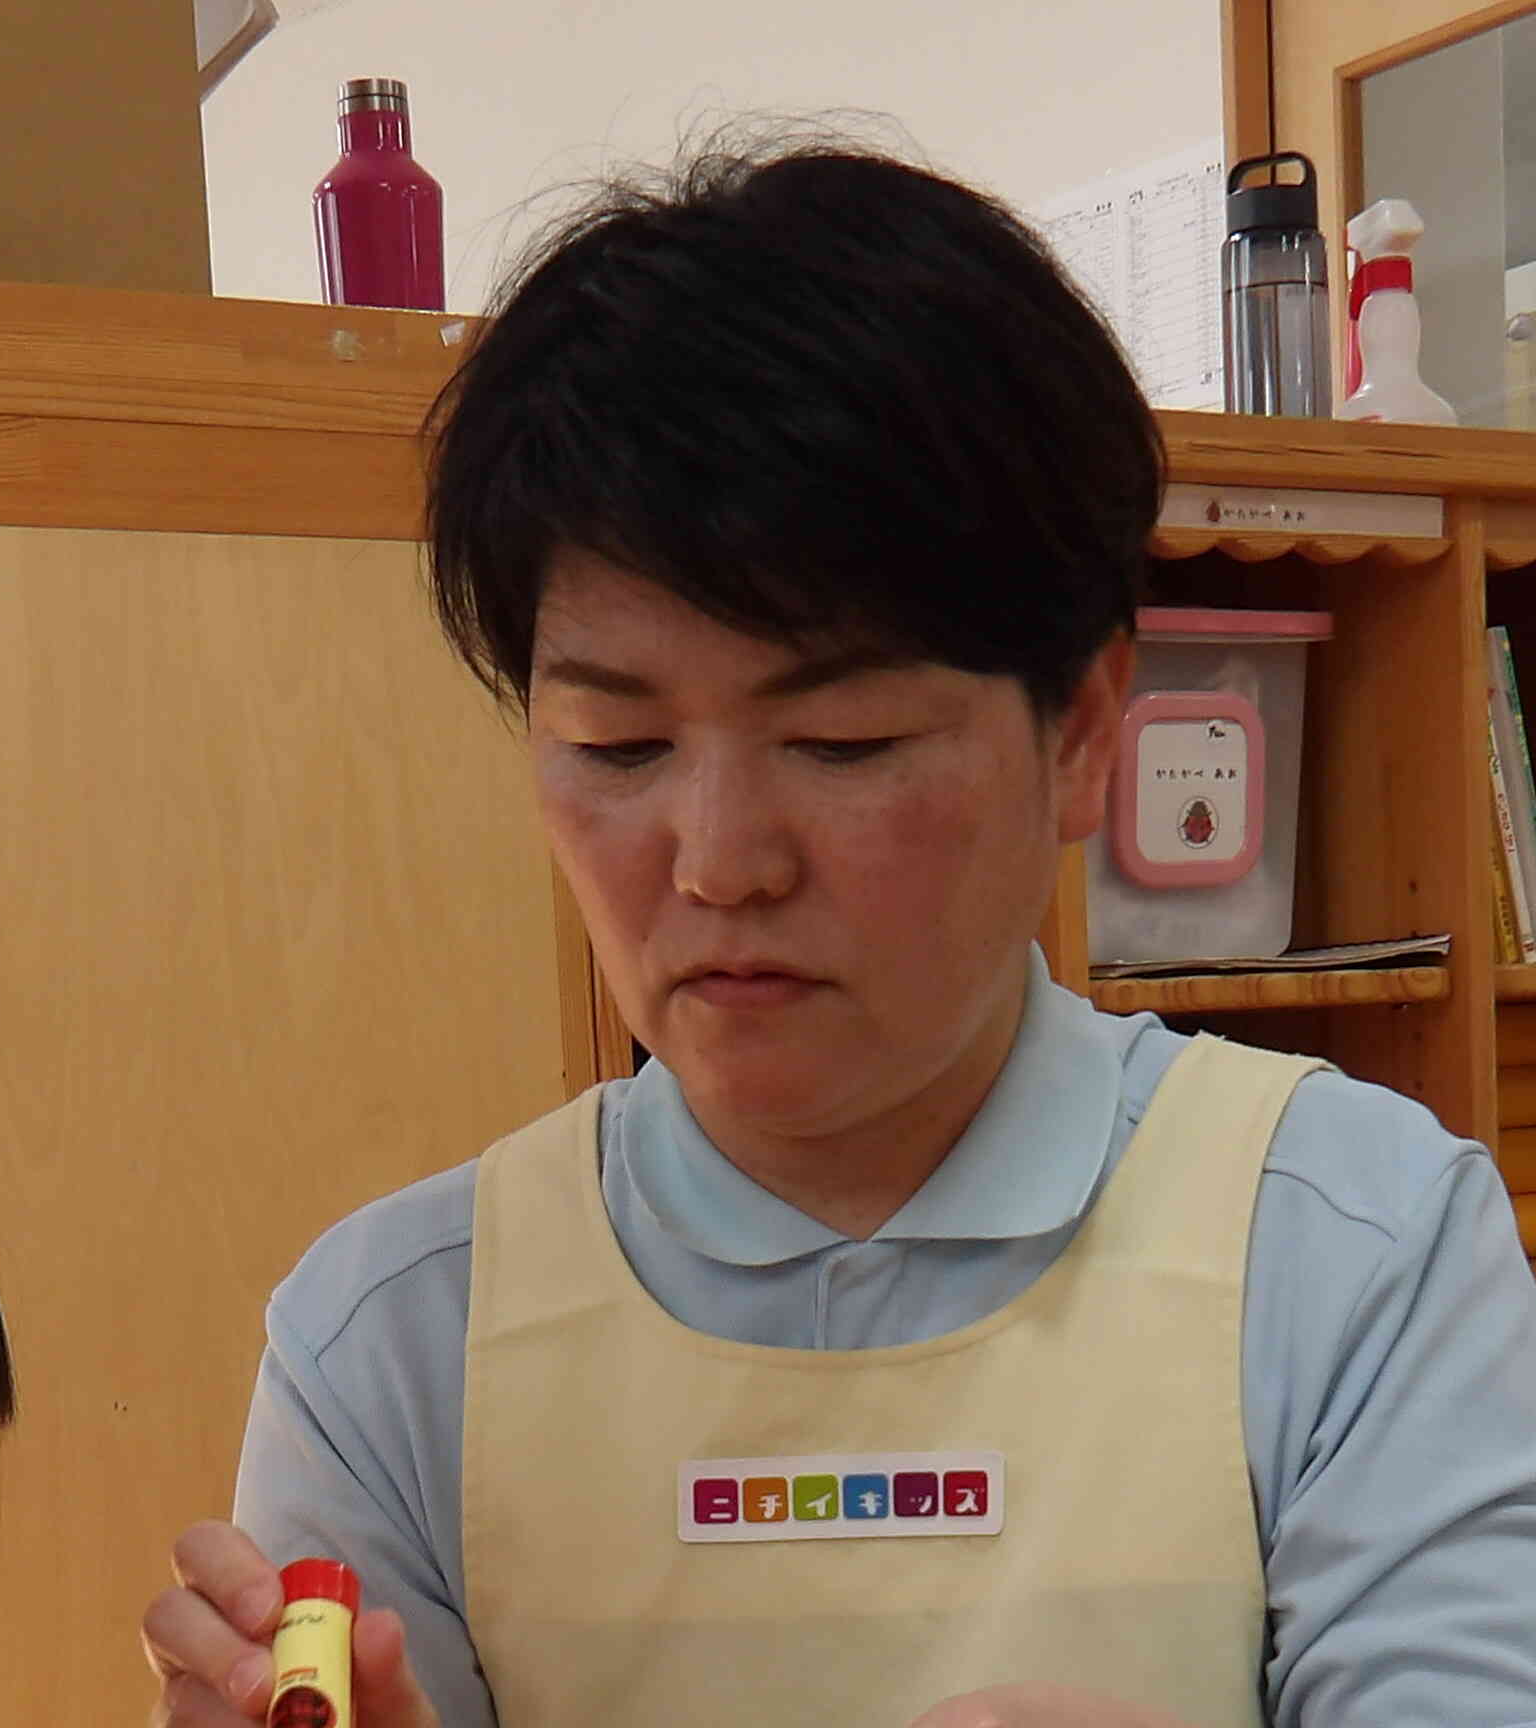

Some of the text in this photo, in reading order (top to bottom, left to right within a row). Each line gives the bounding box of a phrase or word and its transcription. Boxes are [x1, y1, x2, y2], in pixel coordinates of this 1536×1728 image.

[709, 1488, 985, 1519] ニチイキッズ
